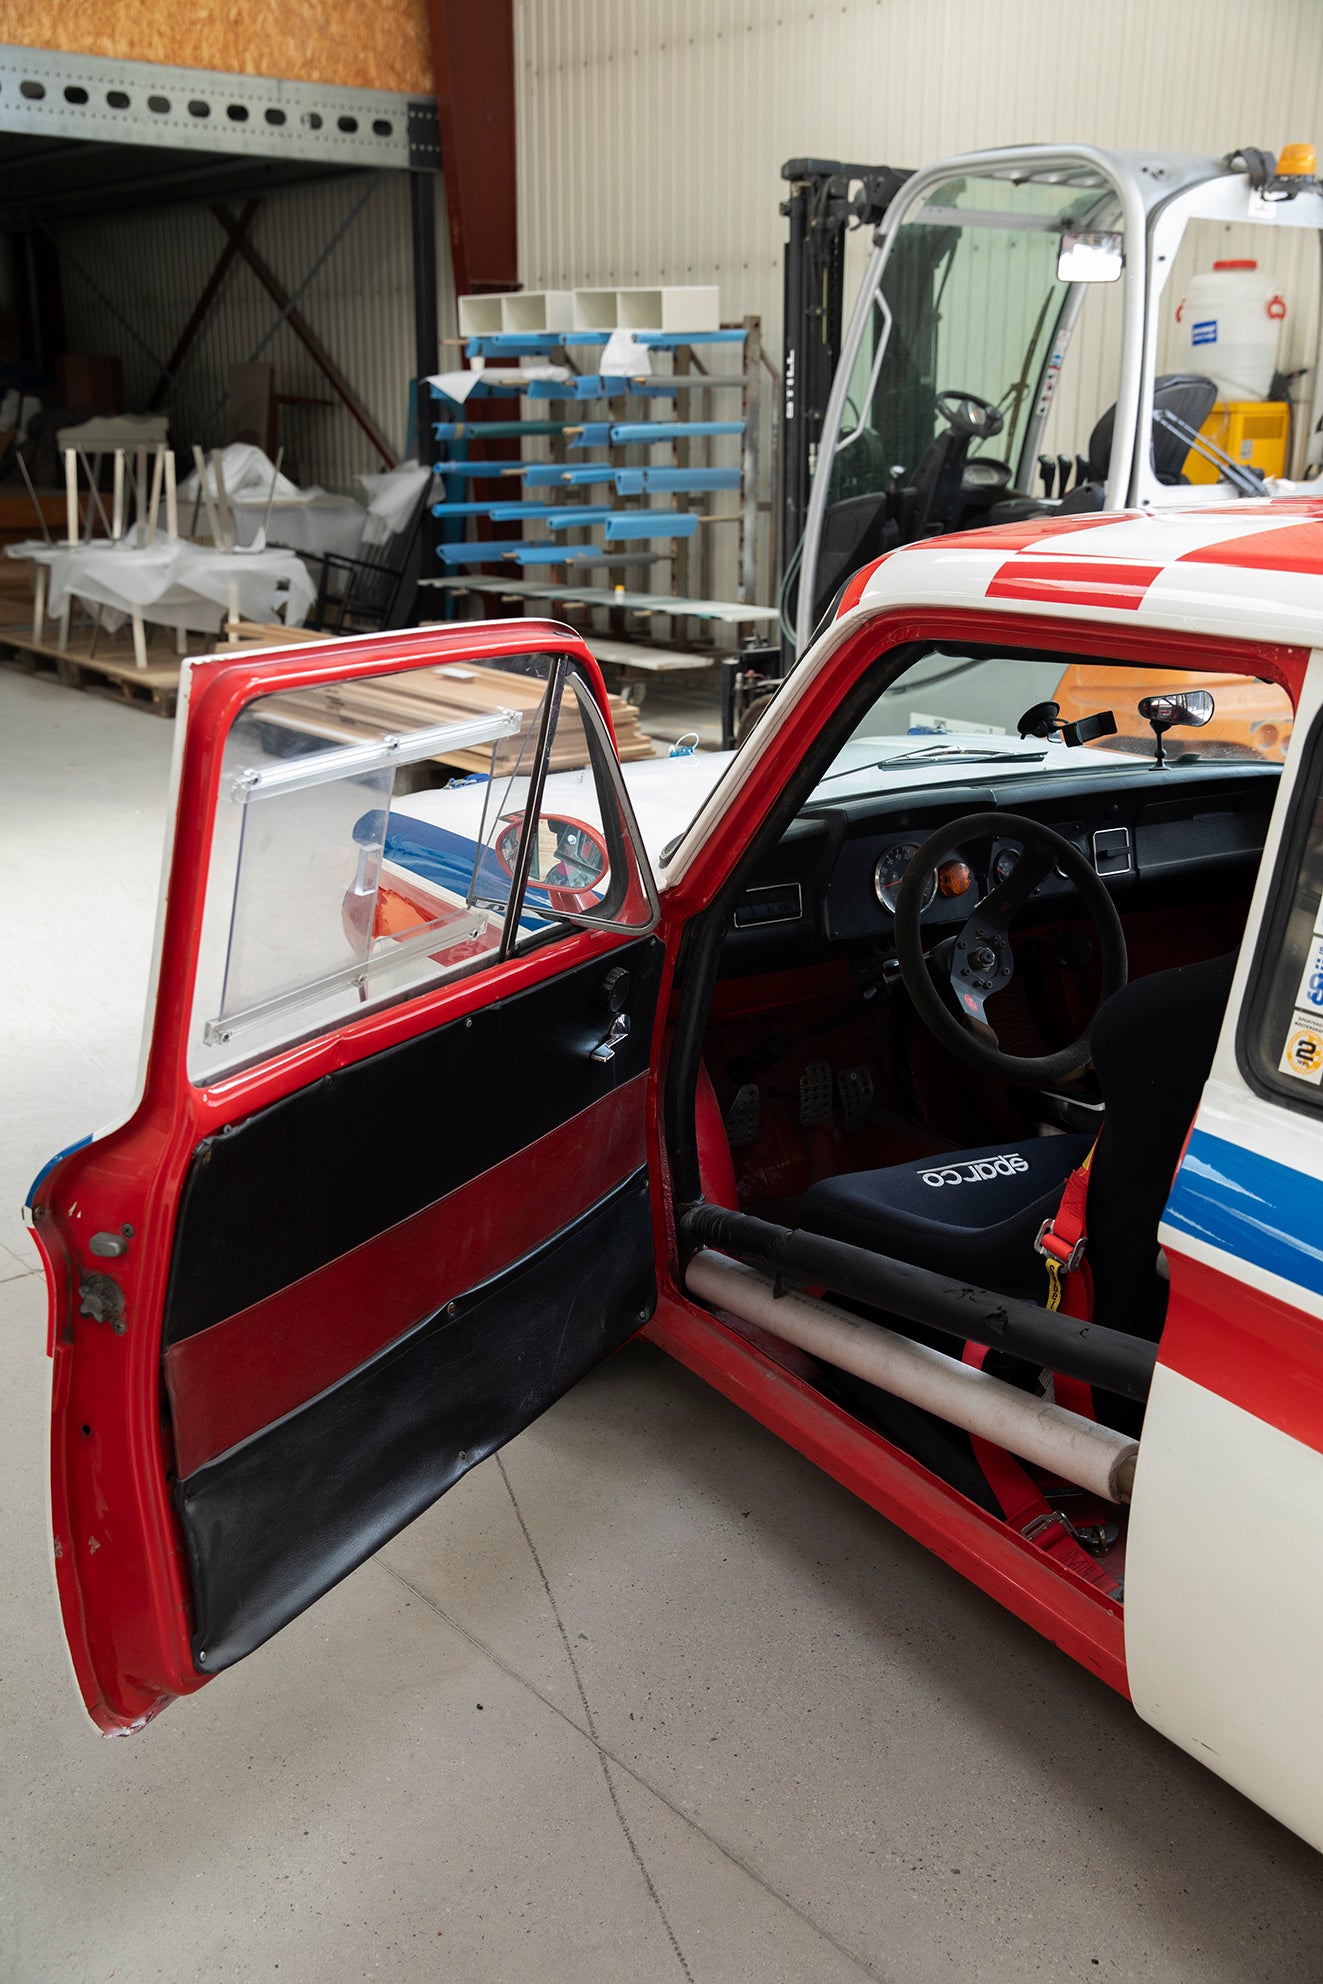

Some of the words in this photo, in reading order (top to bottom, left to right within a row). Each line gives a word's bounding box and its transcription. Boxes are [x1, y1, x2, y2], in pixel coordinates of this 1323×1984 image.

[786, 349, 795, 419] STILL
[1296, 1040, 1316, 1061] 2
[918, 1153, 1029, 1187] sparco
